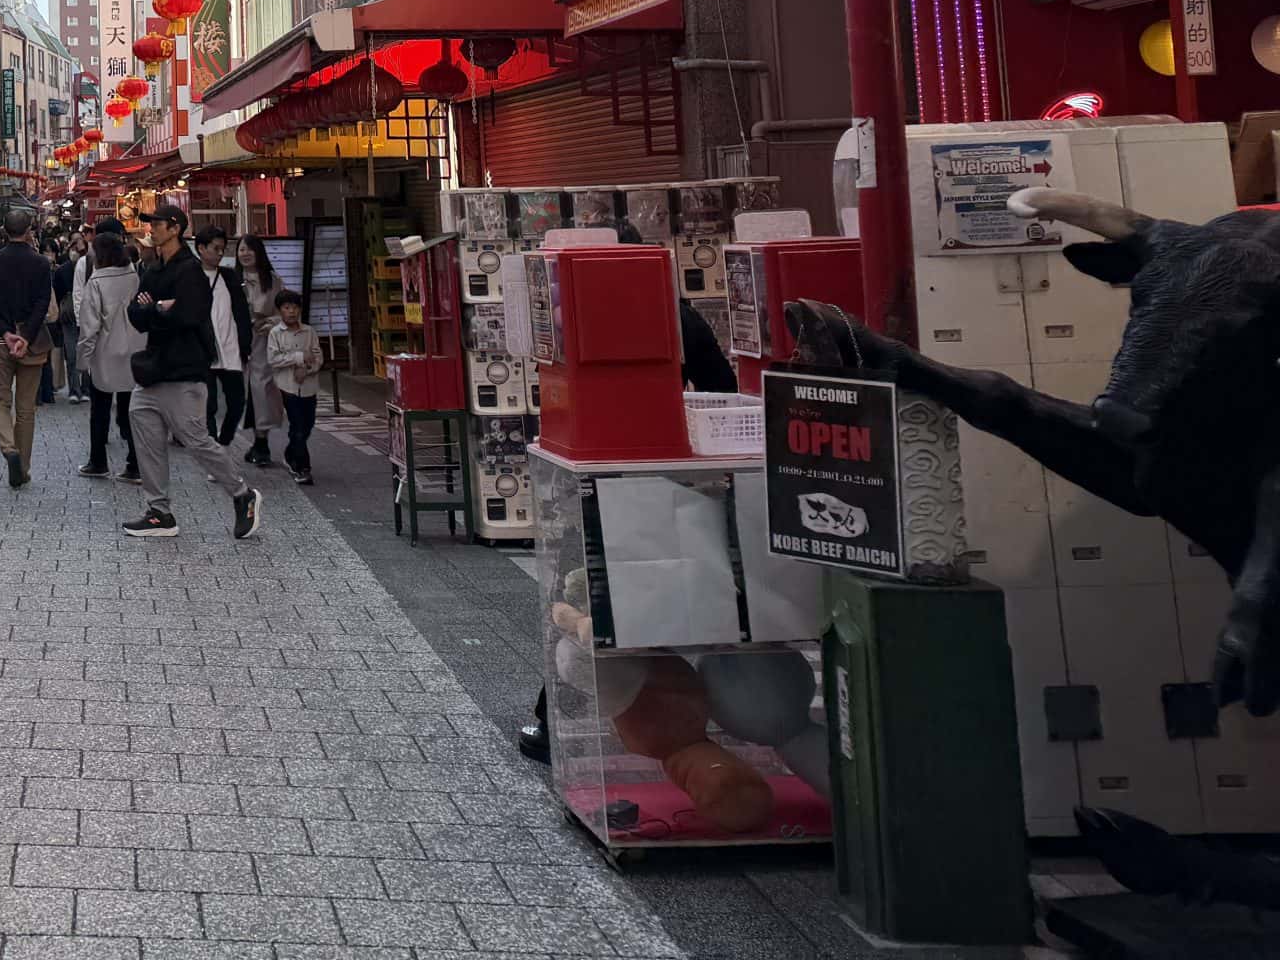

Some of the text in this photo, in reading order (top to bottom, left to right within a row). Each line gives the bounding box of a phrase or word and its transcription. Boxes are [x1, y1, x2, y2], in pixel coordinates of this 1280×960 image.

[1187, 49, 1213, 68] 500
[951, 157, 1027, 176] Welcome!
[794, 385, 858, 405] WELCOME!
[788, 420, 871, 461] OPEN
[773, 533, 896, 567] KOBE BEEF DAICHI
